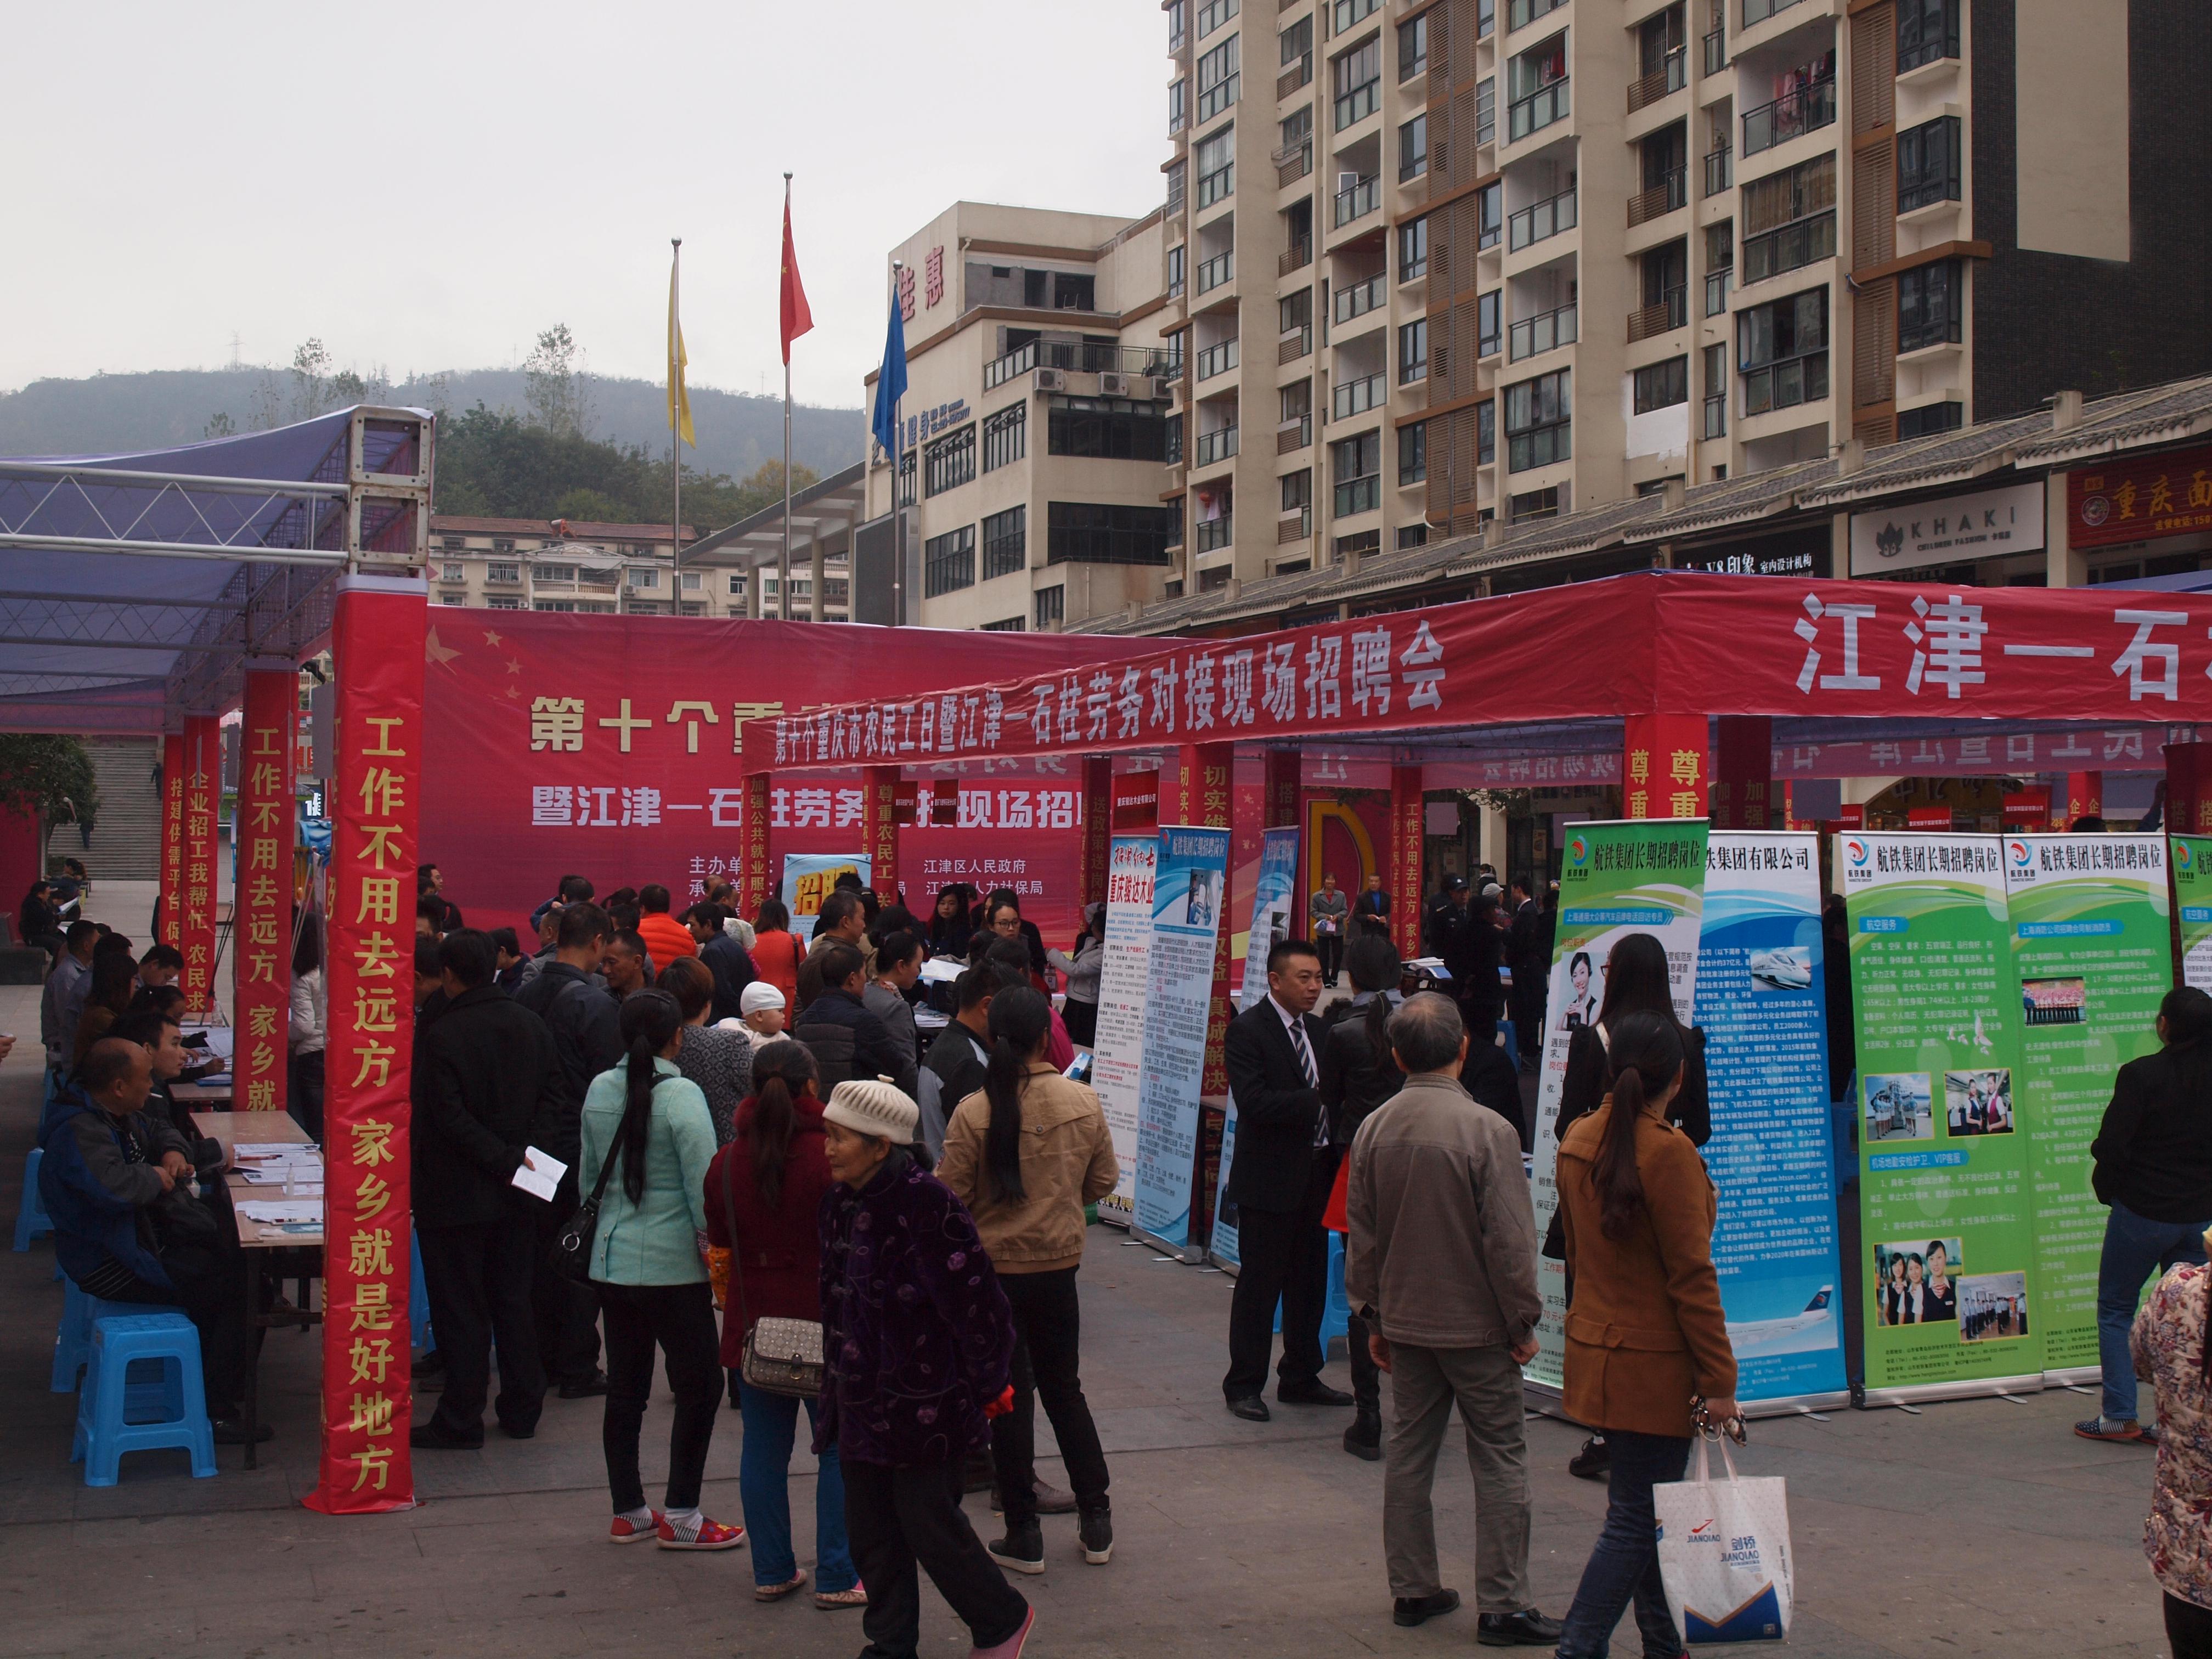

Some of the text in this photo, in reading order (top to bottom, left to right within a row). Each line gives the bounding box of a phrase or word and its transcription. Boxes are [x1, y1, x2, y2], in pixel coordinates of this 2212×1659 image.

[1911, 506, 2015, 539] KHAKI
[750, 777, 765, 908] 加强公共就业服务
[877, 785, 894, 879] 尊重农民工
[188, 771, 210, 930] 企业招工我帮忙
[249, 729, 281, 983] 工作不用去远方
[924, 859, 1026, 874] 江津区人民政府
[1406, 803, 1418, 914] 工作不用去远方
[1594, 841, 1700, 872] 航铁集团长期招聘岗位
[1877, 844, 1999, 873] 航铁集团长期招聘岗位
[2040, 843, 2161, 872] 航铁集团长期招聘岗位
[1848, 870, 1872, 878] 航铁集团
[2010, 869, 2036, 878] 航铁集团
[1866, 920, 1897, 930] 航空服务
[348, 717, 406, 1492] 工作不用去远方 家乡就是好地方
